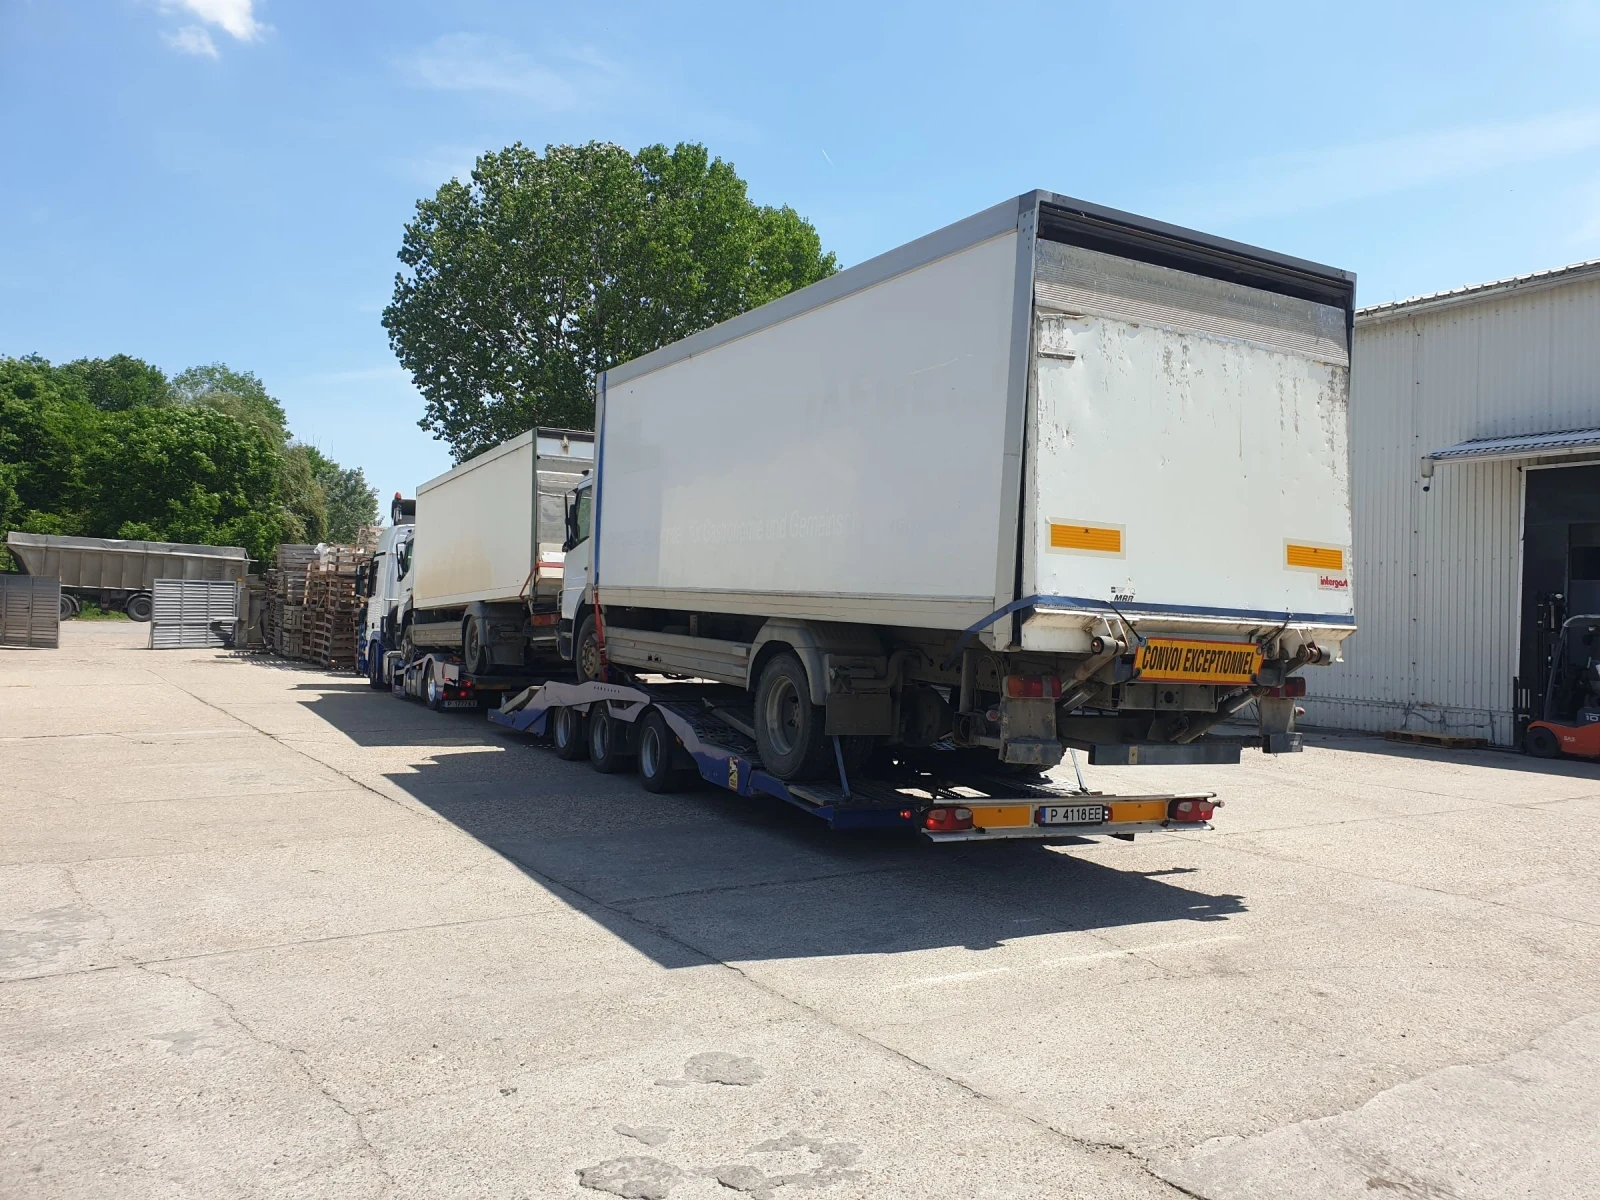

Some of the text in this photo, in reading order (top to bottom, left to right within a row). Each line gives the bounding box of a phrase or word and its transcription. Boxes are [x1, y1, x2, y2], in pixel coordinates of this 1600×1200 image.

[1142, 645, 1254, 675] CONVOI EXCEPTIONNEL
[1050, 807, 1101, 822] P 4118EE
